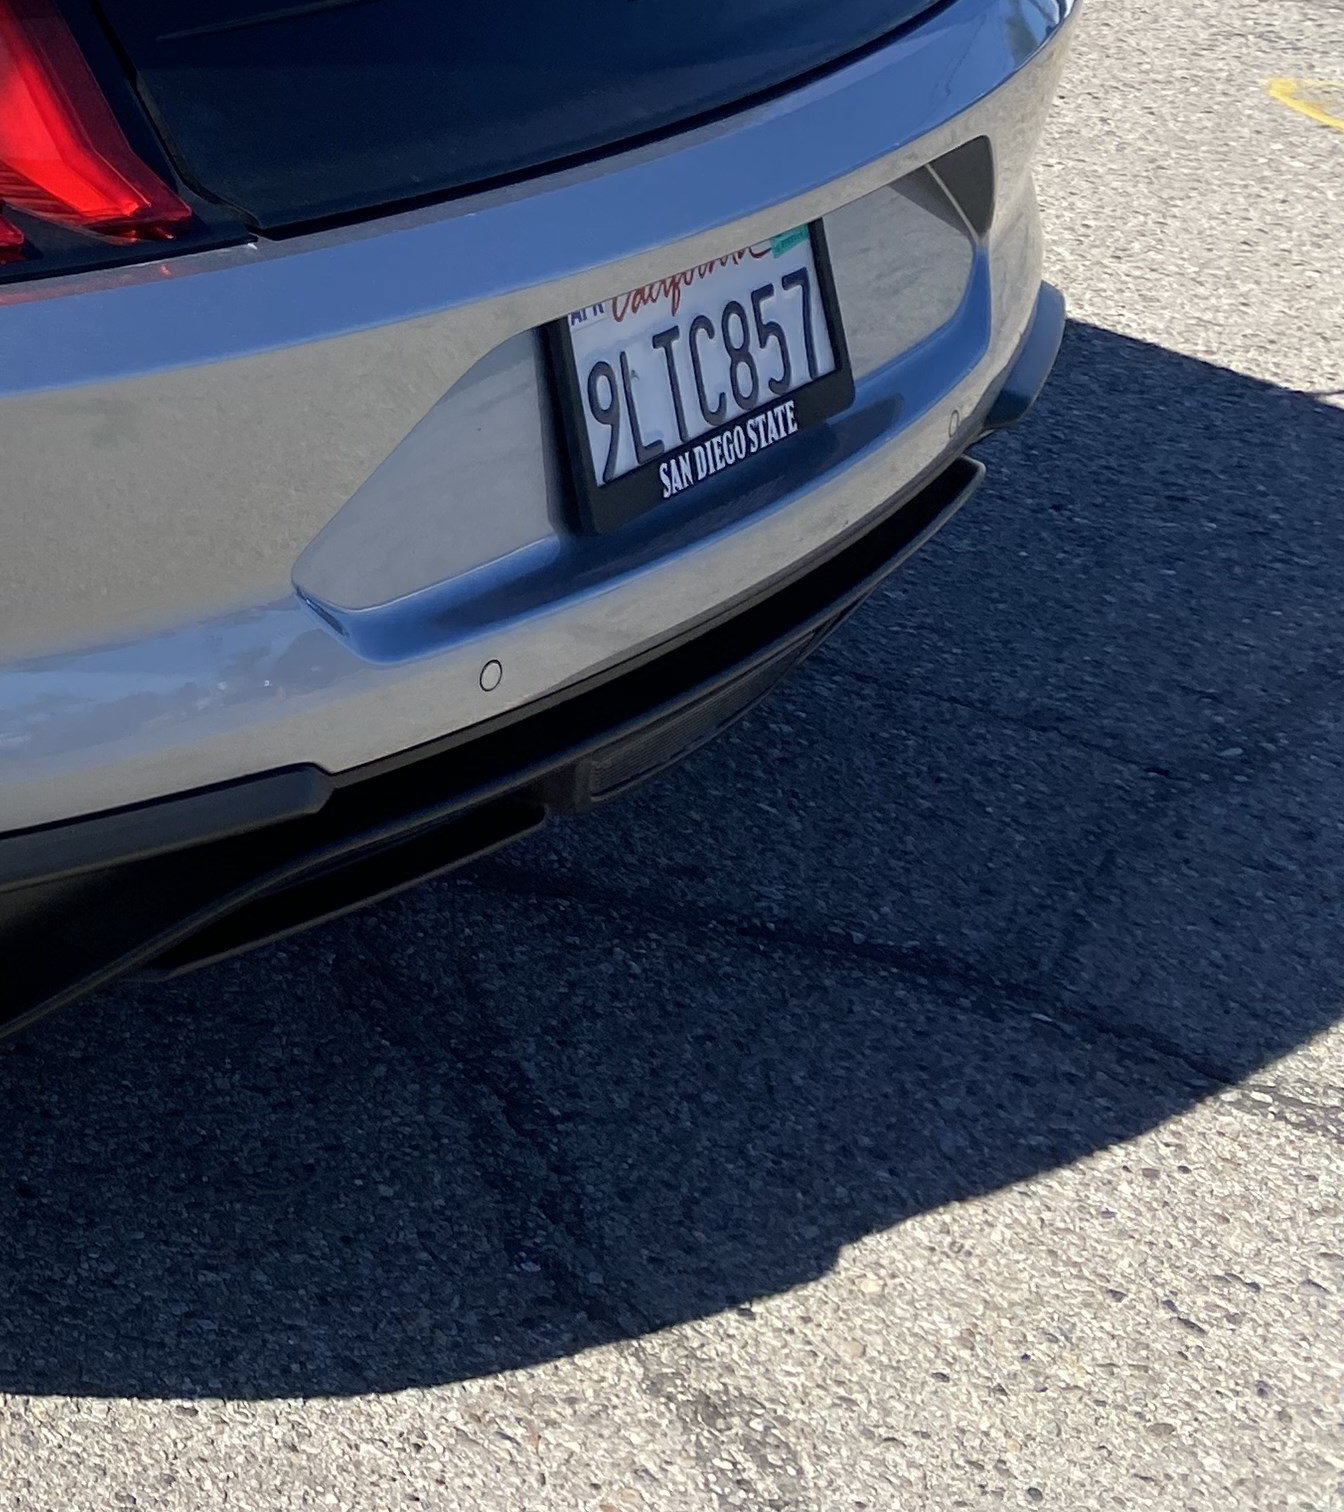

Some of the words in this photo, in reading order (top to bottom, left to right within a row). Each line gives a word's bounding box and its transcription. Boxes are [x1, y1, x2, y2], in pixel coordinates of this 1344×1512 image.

[587, 266, 819, 485] 9LTC857
[659, 449, 694, 498] SAN
[694, 425, 747, 481] DIEGO
[745, 400, 799, 458] STATE
